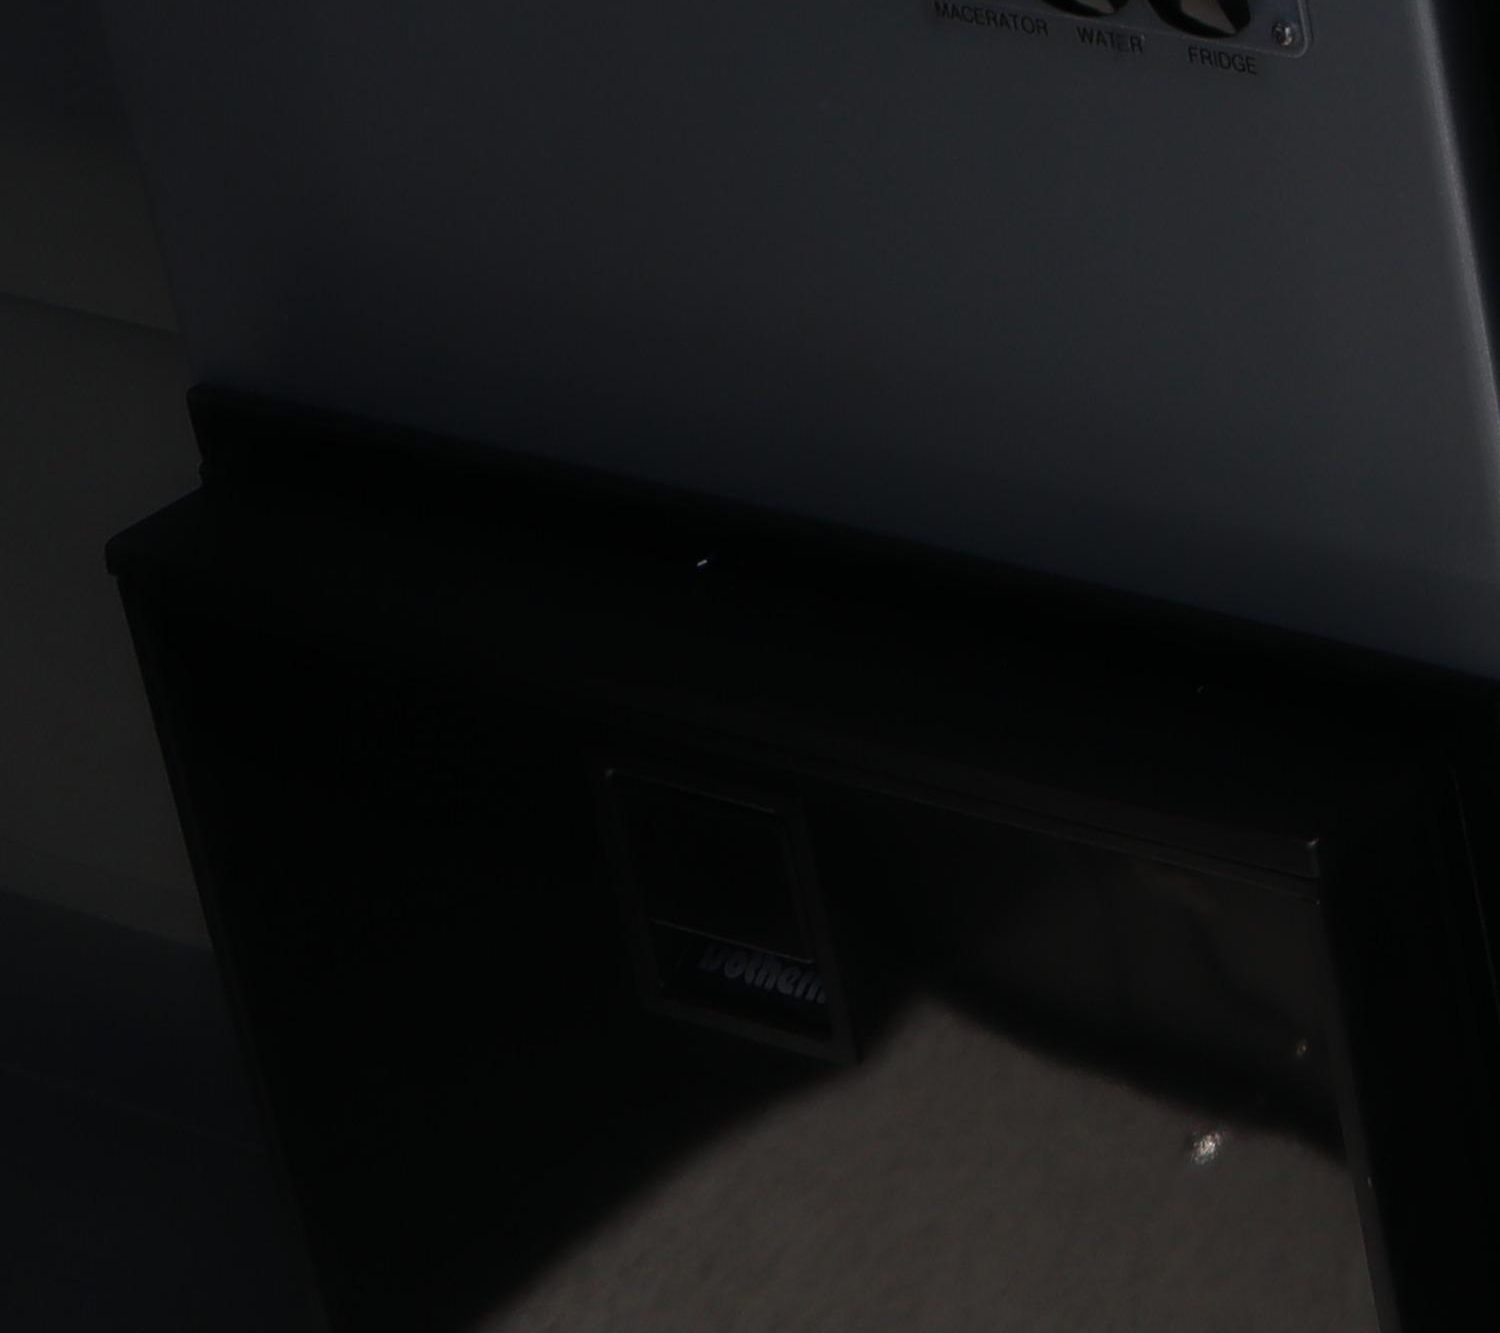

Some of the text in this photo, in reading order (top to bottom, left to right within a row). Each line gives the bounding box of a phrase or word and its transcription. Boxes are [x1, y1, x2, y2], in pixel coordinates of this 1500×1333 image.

[934, 1, 1258, 76] MACERATOR WATER FRIDGE
